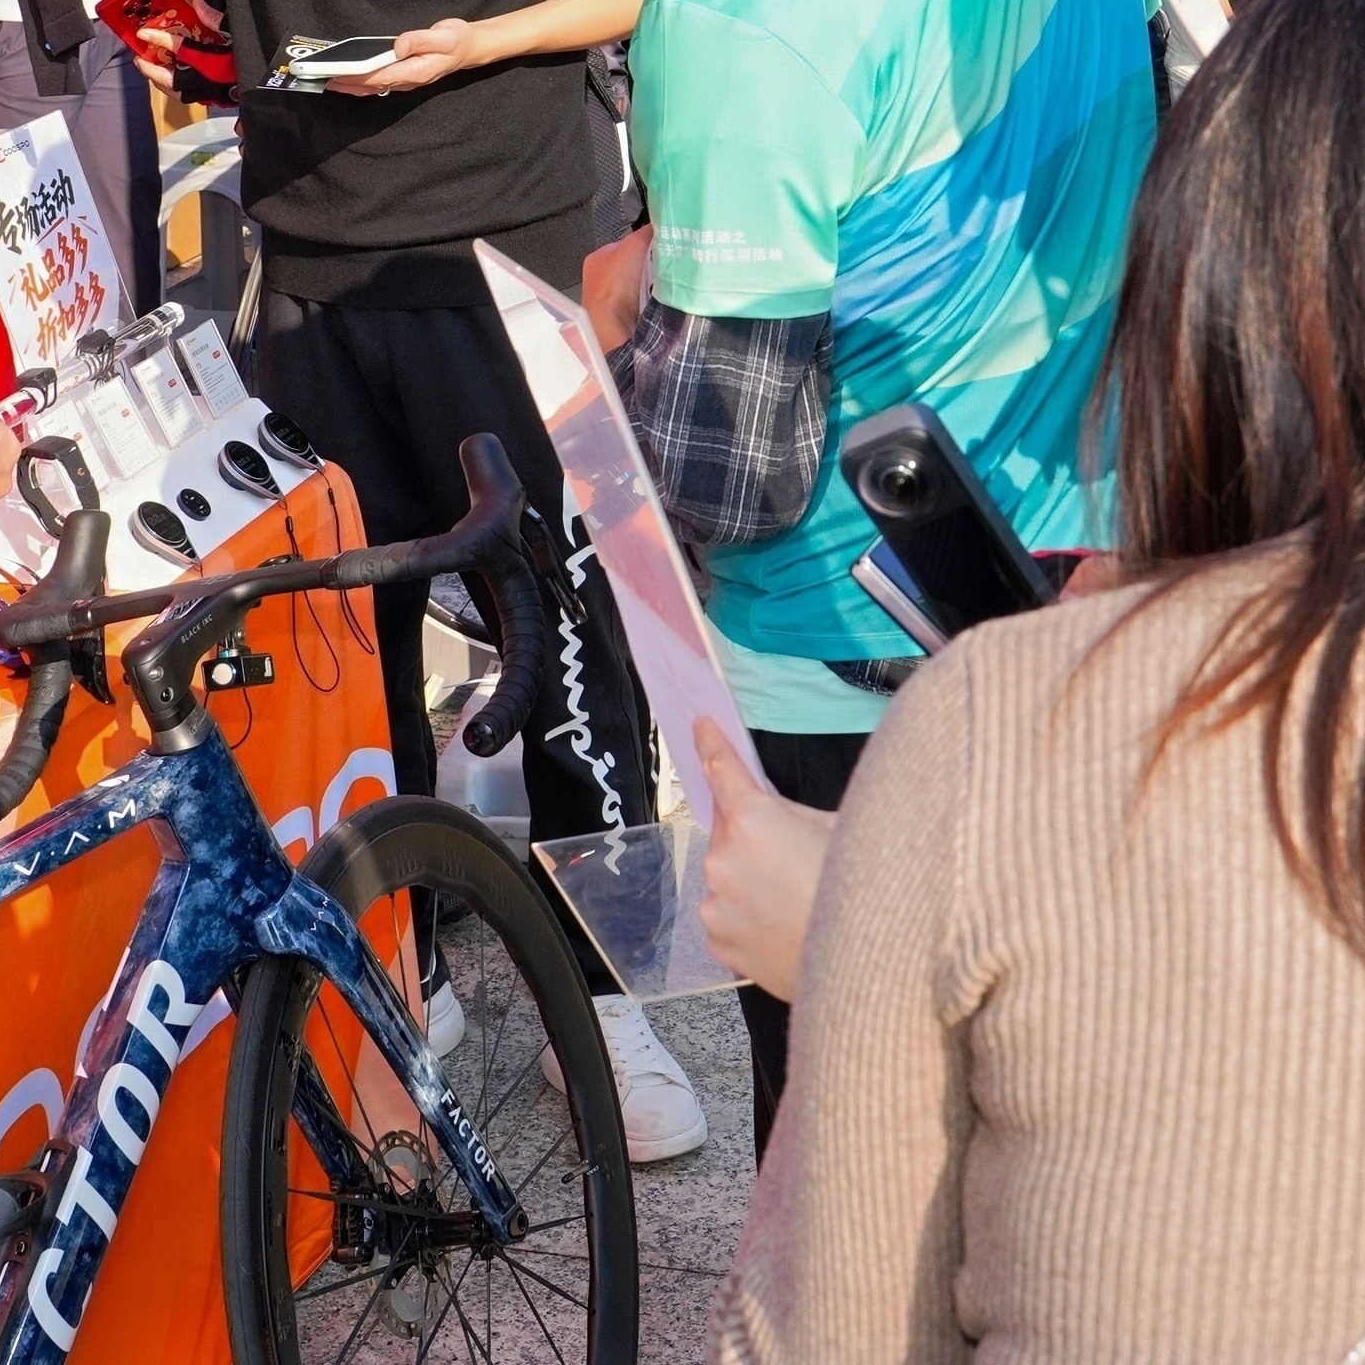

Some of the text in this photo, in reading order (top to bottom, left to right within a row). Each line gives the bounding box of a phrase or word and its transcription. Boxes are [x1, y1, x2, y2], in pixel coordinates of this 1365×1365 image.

[3, 139, 31, 157] COOSPO
[20, 222, 89, 312] 礼品多多
[36, 270, 106, 369] 折扣多多
[180, 613, 214, 644] BLACK INC
[439, 1087, 496, 1183] FACTOR
